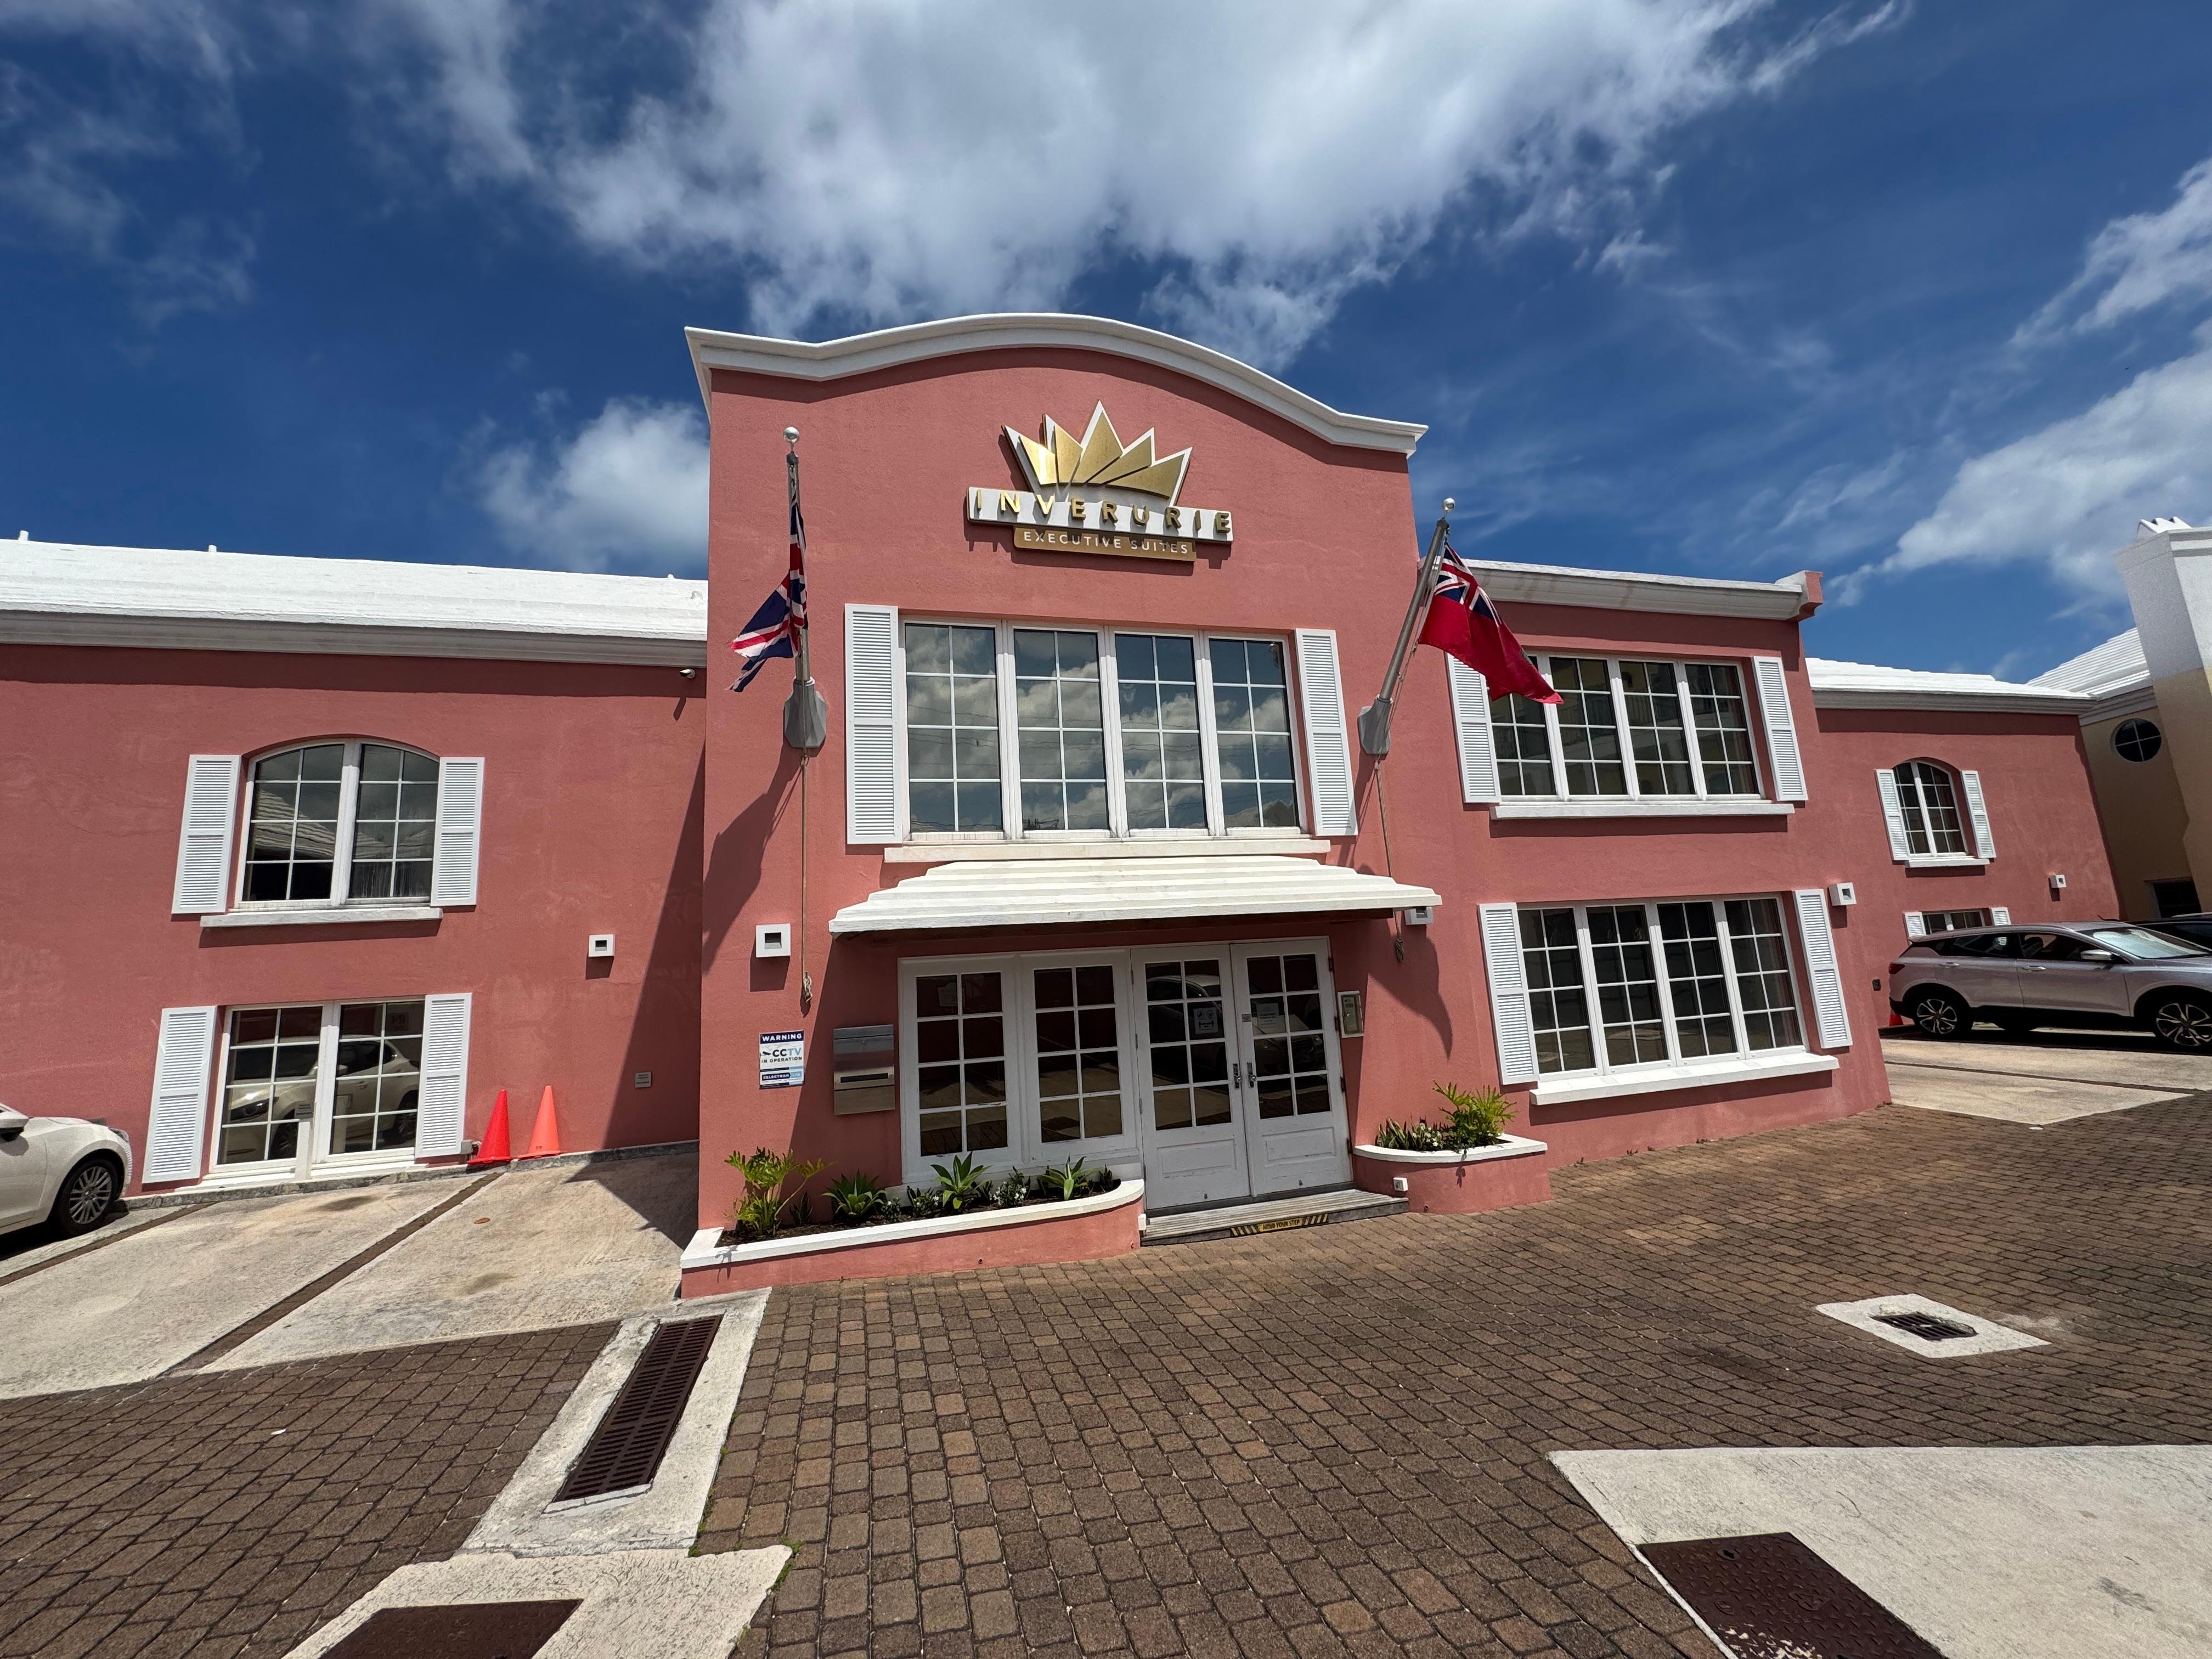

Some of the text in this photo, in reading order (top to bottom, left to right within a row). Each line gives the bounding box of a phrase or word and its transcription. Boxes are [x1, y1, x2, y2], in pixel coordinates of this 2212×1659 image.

[976, 489, 1232, 533] INVERURIE
[1023, 531, 1188, 554] EXECUTIVE SUITES
[762, 1033, 802, 1042] WARNING
[772, 1047, 802, 1057] CCTV
